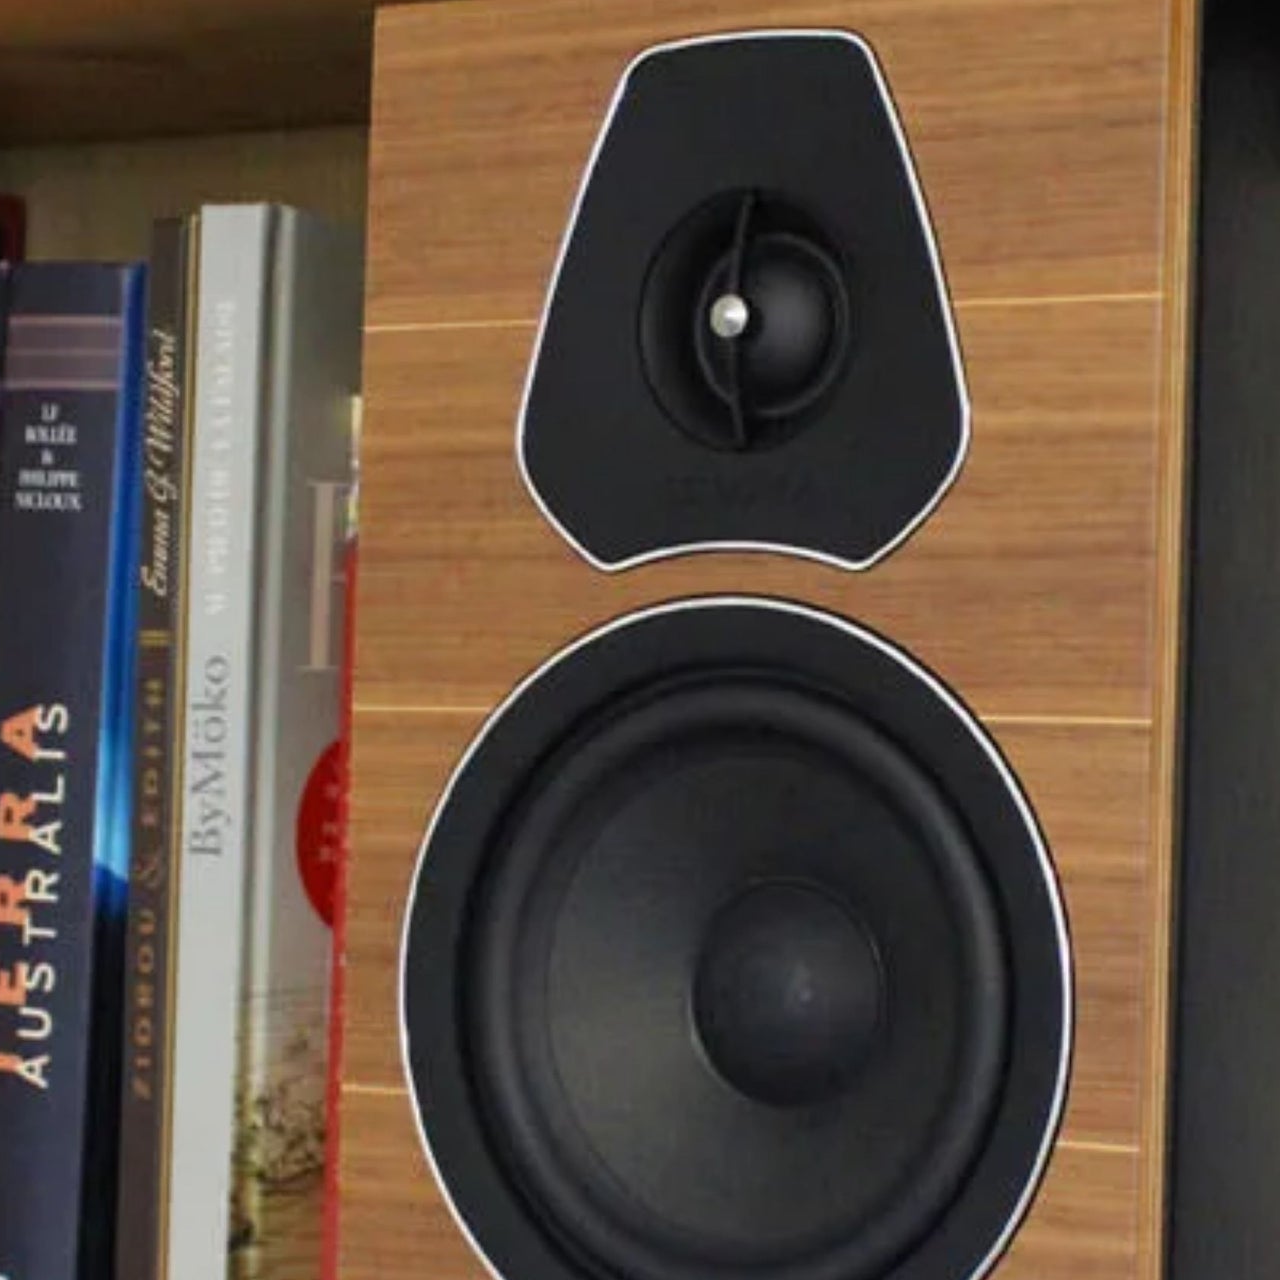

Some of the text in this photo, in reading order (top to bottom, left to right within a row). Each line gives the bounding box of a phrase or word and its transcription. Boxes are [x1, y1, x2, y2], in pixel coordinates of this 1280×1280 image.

[144, 328, 180, 468] Wildford
[139, 510, 171, 596] Emma
[187, 654, 231, 859] ByMöko
[18, 702, 69, 1090] AUSTRALIS
[131, 908, 156, 1101] ZIDROU
